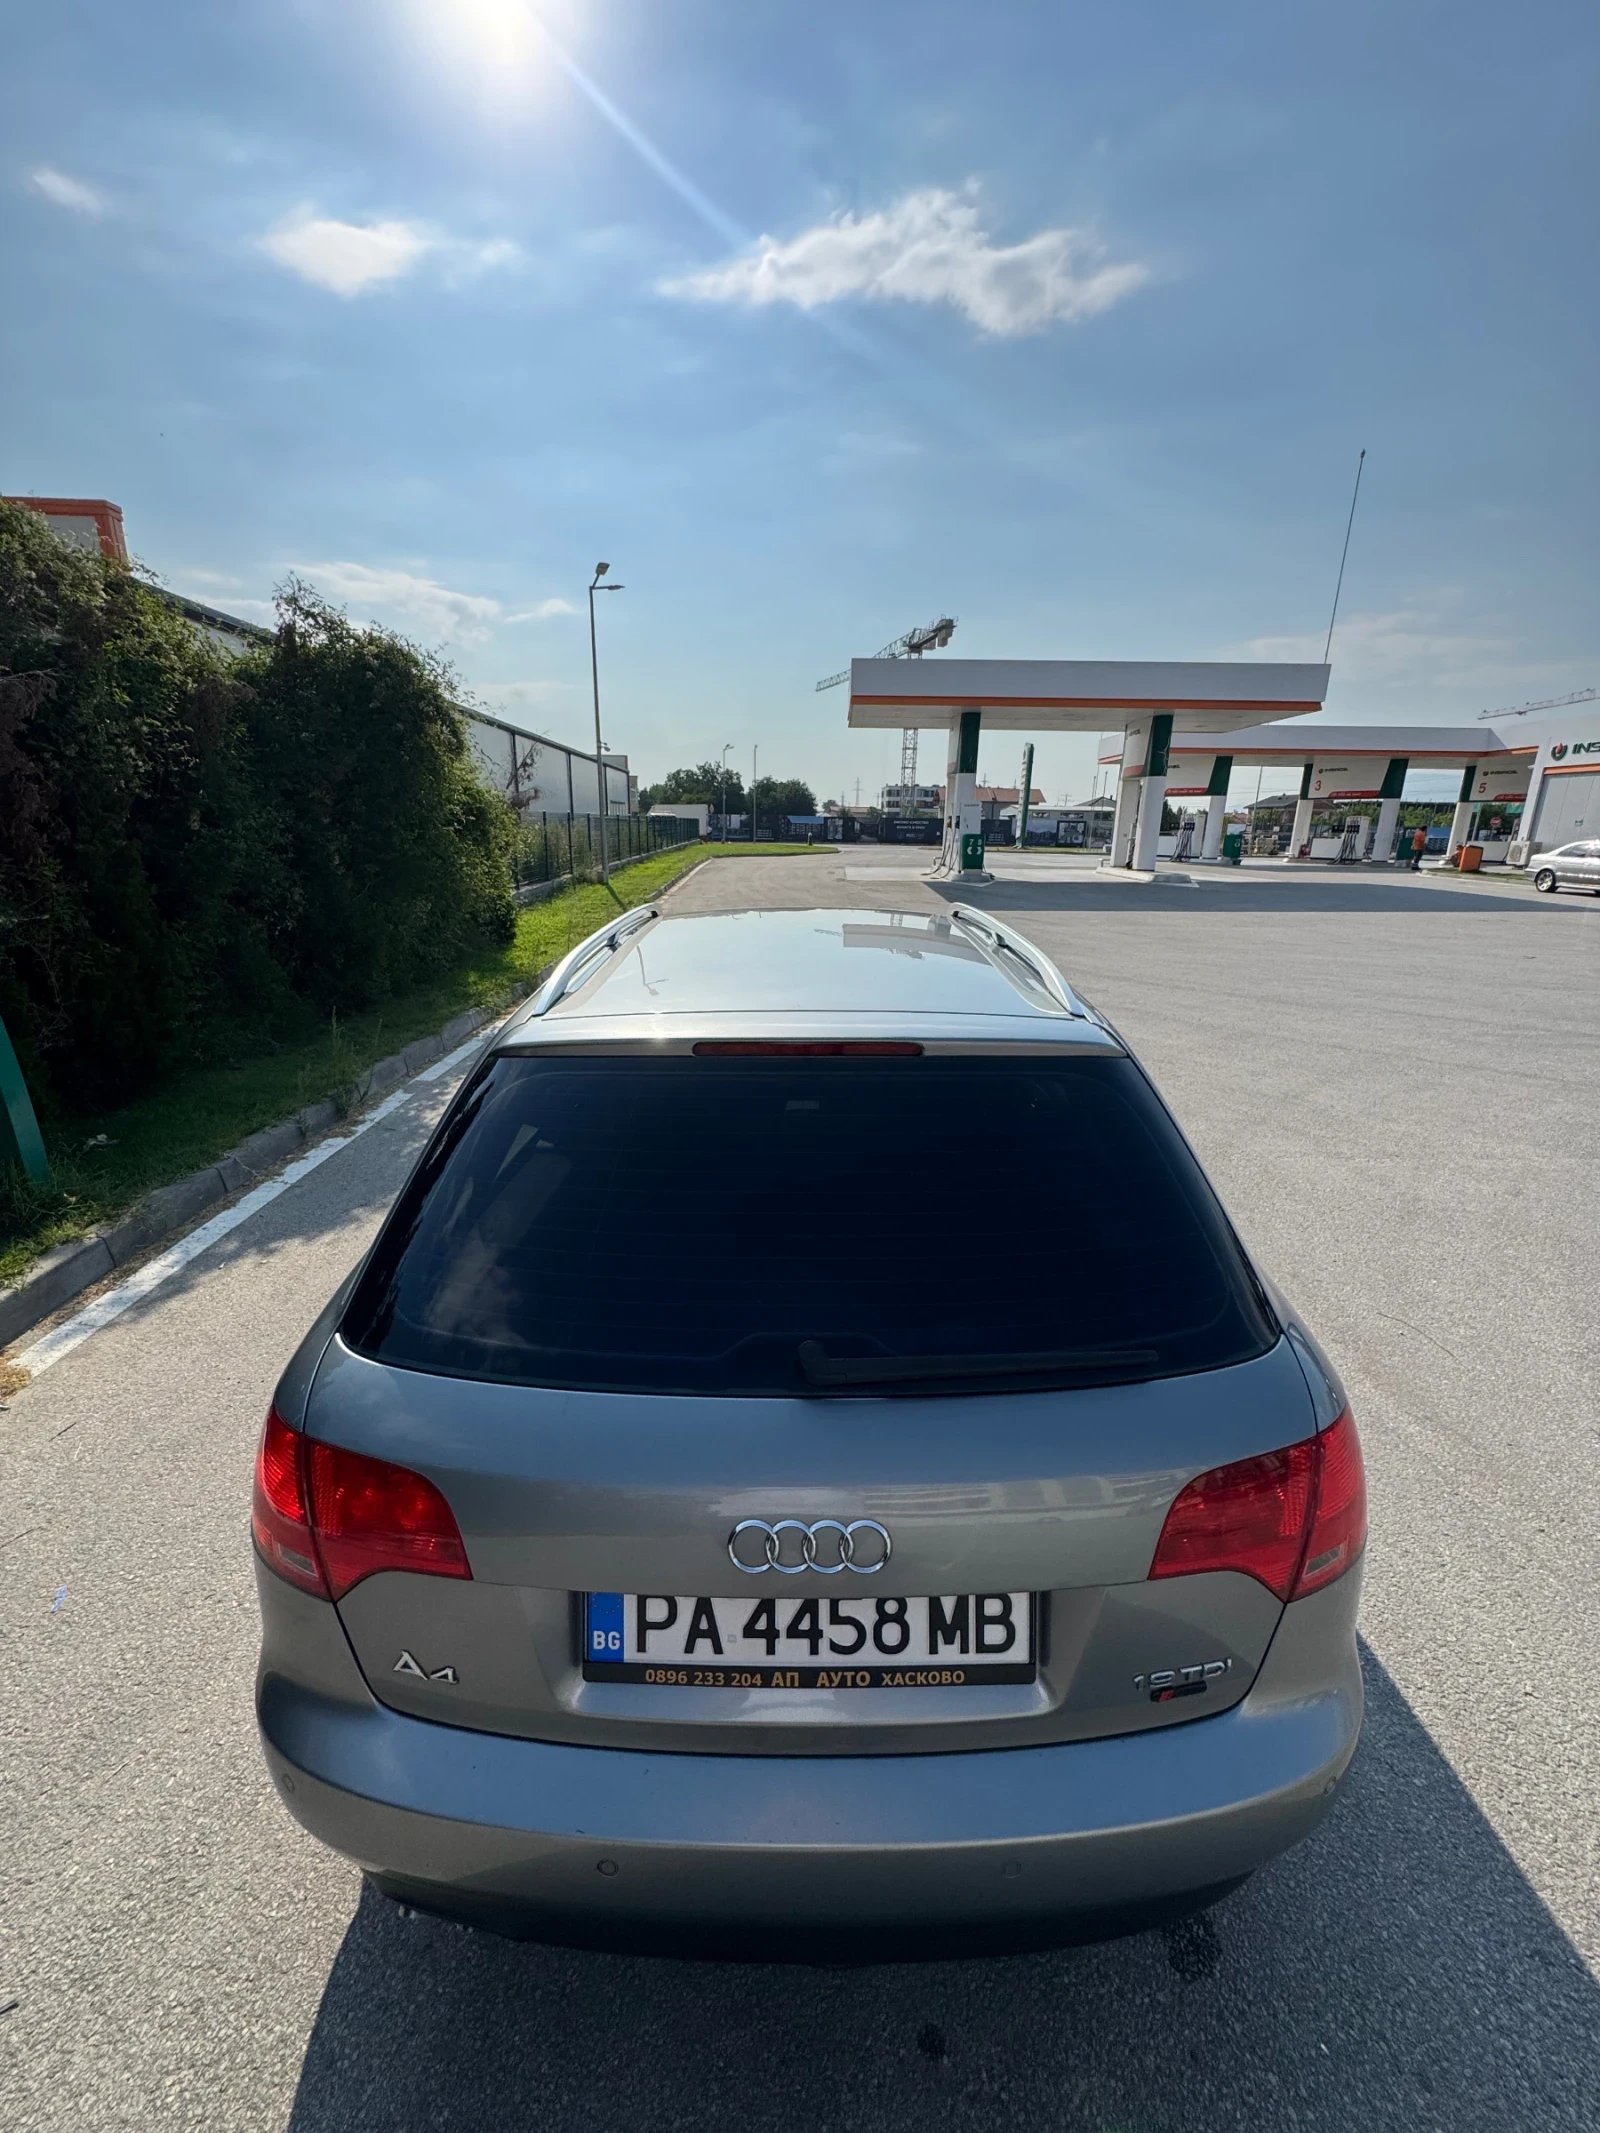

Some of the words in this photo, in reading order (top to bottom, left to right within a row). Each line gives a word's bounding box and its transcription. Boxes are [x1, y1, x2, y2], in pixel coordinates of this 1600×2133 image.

[1314, 780, 1322, 791] 3
[1478, 782, 1487, 793] 5
[969, 838, 975, 846] 7
[636, 1594, 724, 1655] PA
[742, 1596, 910, 1656] 4458
[928, 1591, 1016, 1655] MB
[592, 1630, 621, 1650] BG
[393, 1649, 460, 1685] A4
[1179, 1657, 1233, 1681] TDI
[645, 1668, 688, 1684] 0896
[693, 1671, 725, 1686] 233
[730, 1671, 763, 1687] 204
[770, 1671, 800, 1687] АП
[816, 1670, 872, 1688] АУТО
[881, 1670, 966, 1686] ХАСКОВО
